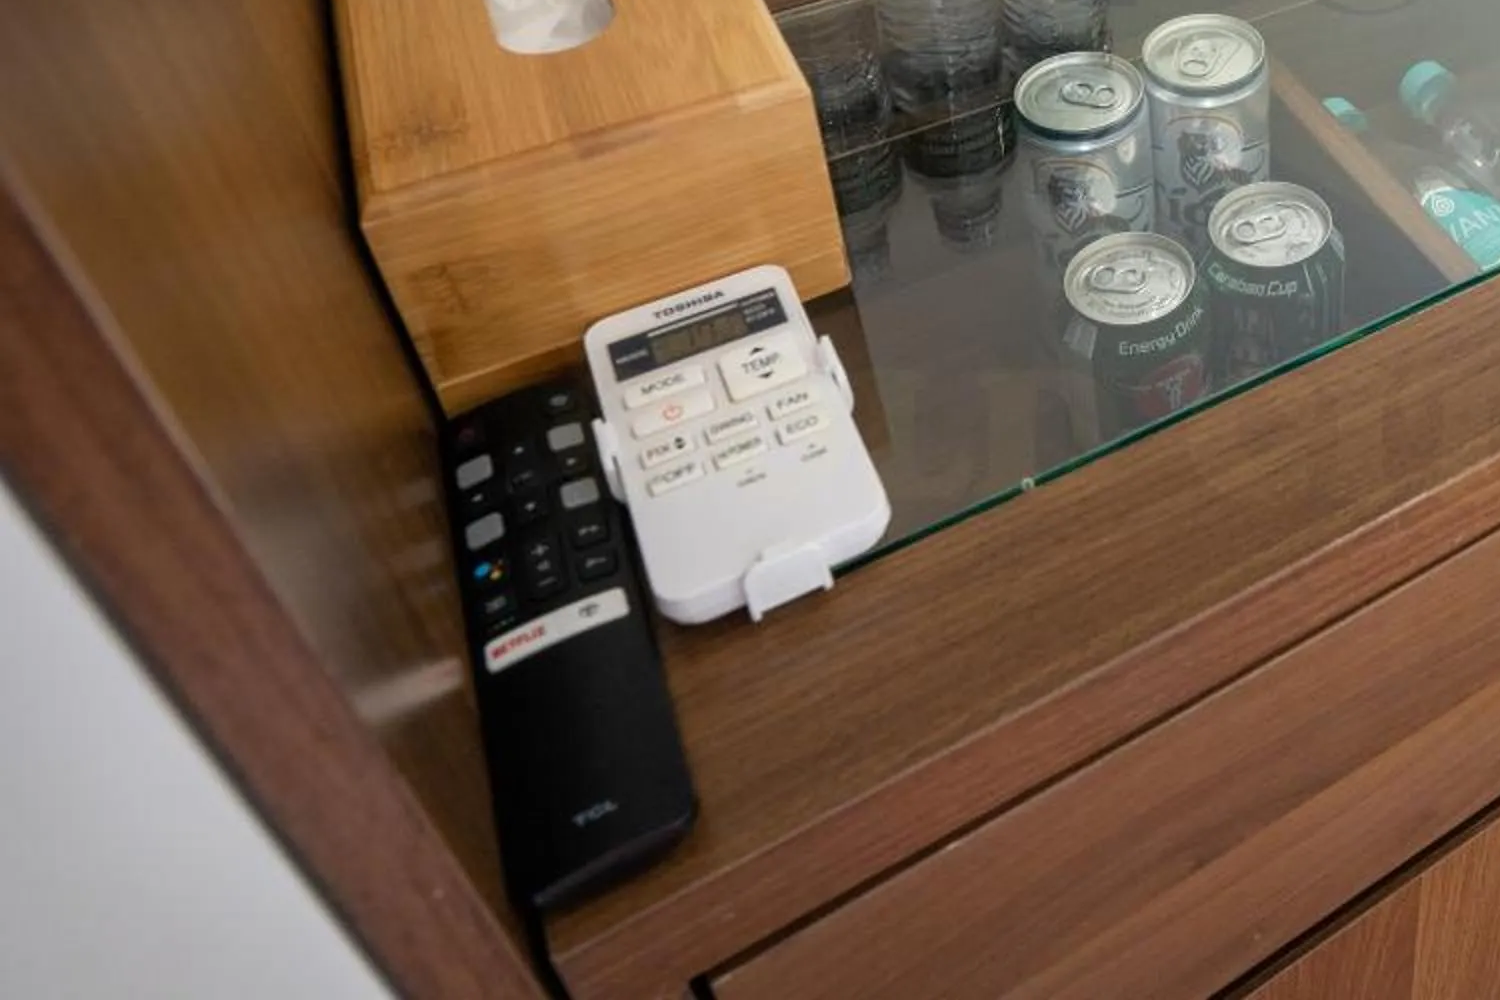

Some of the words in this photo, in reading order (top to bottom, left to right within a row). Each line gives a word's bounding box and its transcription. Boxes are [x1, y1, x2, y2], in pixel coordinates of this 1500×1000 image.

[1266, 280, 1298, 299] Cup
[652, 290, 726, 320] TOSHIBA
[1118, 331, 1177, 357] Energy
[1175, 307, 1204, 339] Drink
[640, 373, 687, 396] MODE
[776, 391, 809, 411] FAN
[785, 415, 820, 435] ECO
